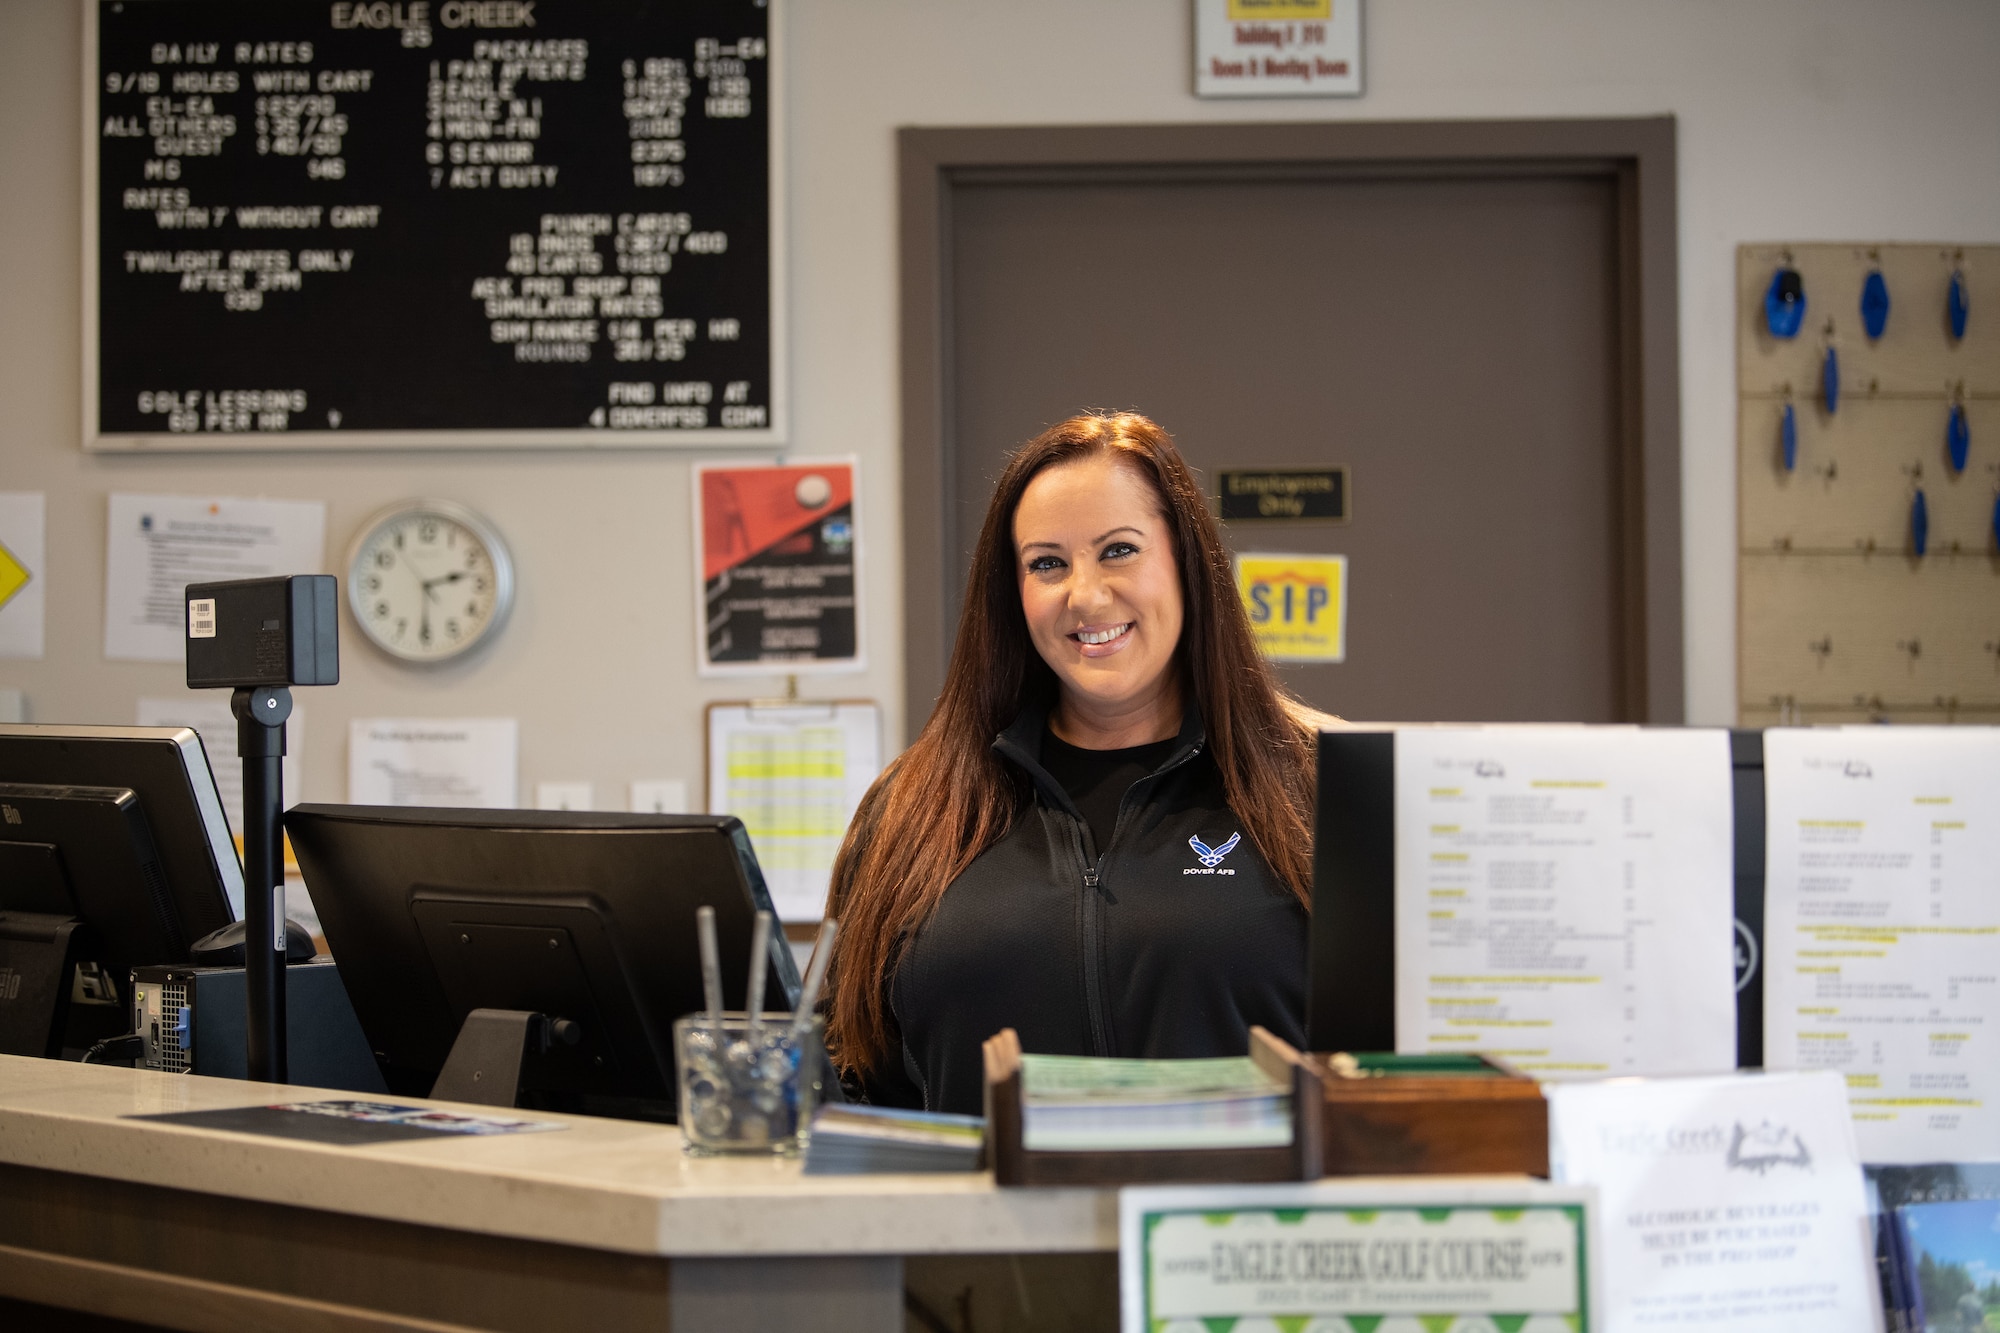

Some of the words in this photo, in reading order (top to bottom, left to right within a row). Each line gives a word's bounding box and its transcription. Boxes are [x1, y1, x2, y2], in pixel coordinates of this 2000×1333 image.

[331, 2, 430, 28] EAGLE
[441, 1, 537, 27] CREEK
[152, 43, 219, 63] DAILY
[235, 42, 313, 62] RATES
[173, 72, 239, 92] HOLES
[254, 72, 309, 92] WITH
[318, 71, 373, 91] CART
[104, 116, 145, 136] ALL
[150, 116, 236, 136] OTHERS
[450, 167, 494, 188] ACT
[499, 166, 559, 188] DUTY
[124, 189, 189, 209] RATES
[156, 207, 208, 228] WITH
[236, 207, 323, 228] WITHOUT
[331, 207, 381, 228] CART
[124, 252, 222, 272] TWILIGHT
[229, 251, 290, 271] RATES
[299, 250, 353, 271] ONLY
[180, 271, 245, 291] AFTER
[654, 319, 696, 340] PER
[138, 392, 201, 412] GOLF
[206, 391, 307, 411] LESSONS
[724, 382, 750, 403] AT
[206, 410, 251, 431] PER
[258, 410, 288, 430] HR
[1258, 494, 1305, 516] Only
[1, 804, 22, 824] elo
[1725, 1201, 1821, 1221] BEVERAGES
[1714, 1221, 1811, 1241] PURCHASED
[1211, 1240, 1288, 1283] EAGLE
[1289, 1240, 1367, 1283] CREEK
[1370, 1239, 1434, 1282] GOLF
[1436, 1238, 1528, 1282] COURSE
[1307, 1285, 1355, 1304] Golf
[1358, 1285, 1494, 1304] Tournaments
